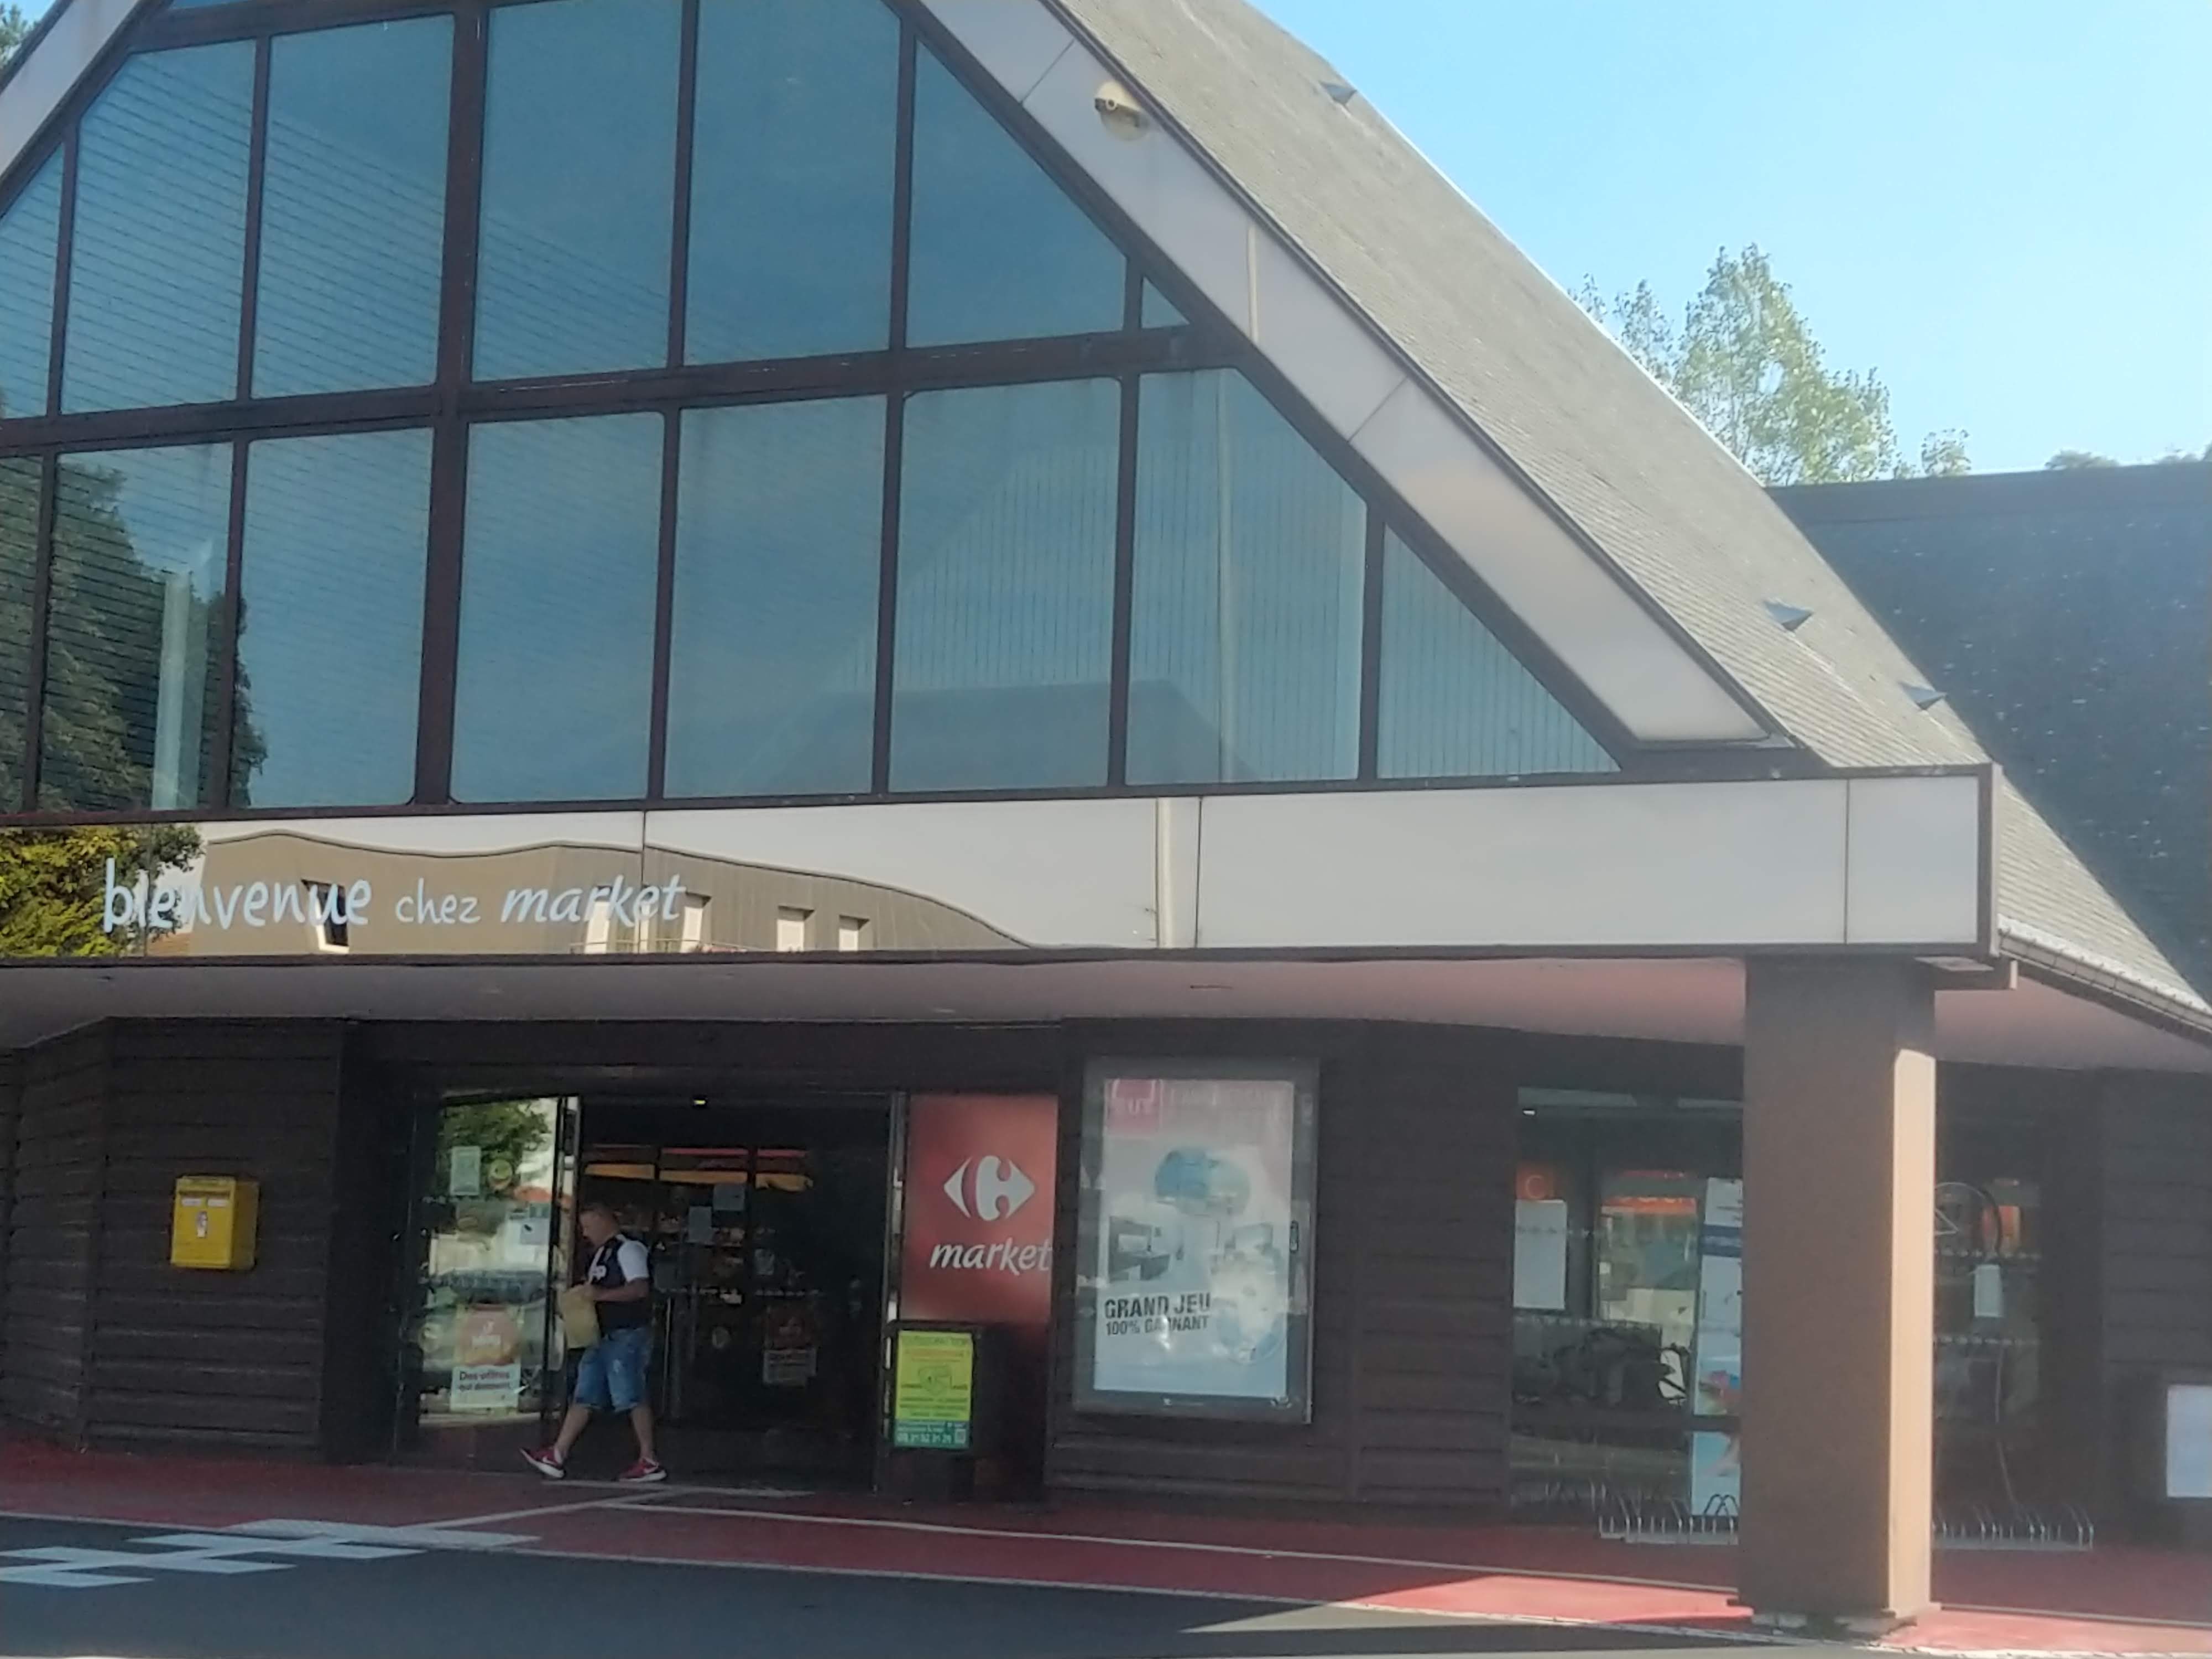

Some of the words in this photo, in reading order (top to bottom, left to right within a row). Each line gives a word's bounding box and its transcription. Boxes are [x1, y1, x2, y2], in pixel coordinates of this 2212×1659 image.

[103, 857, 371, 933] bienvenue
[395, 878, 481, 925] chez
[500, 874, 686, 927] market
[930, 1237, 1052, 1276] market
[1105, 1296, 1169, 1319] GRAND
[1173, 1291, 1211, 1314] JEU
[1106, 1319, 1140, 1336] 100%
[1145, 1314, 1209, 1333] GANANT
